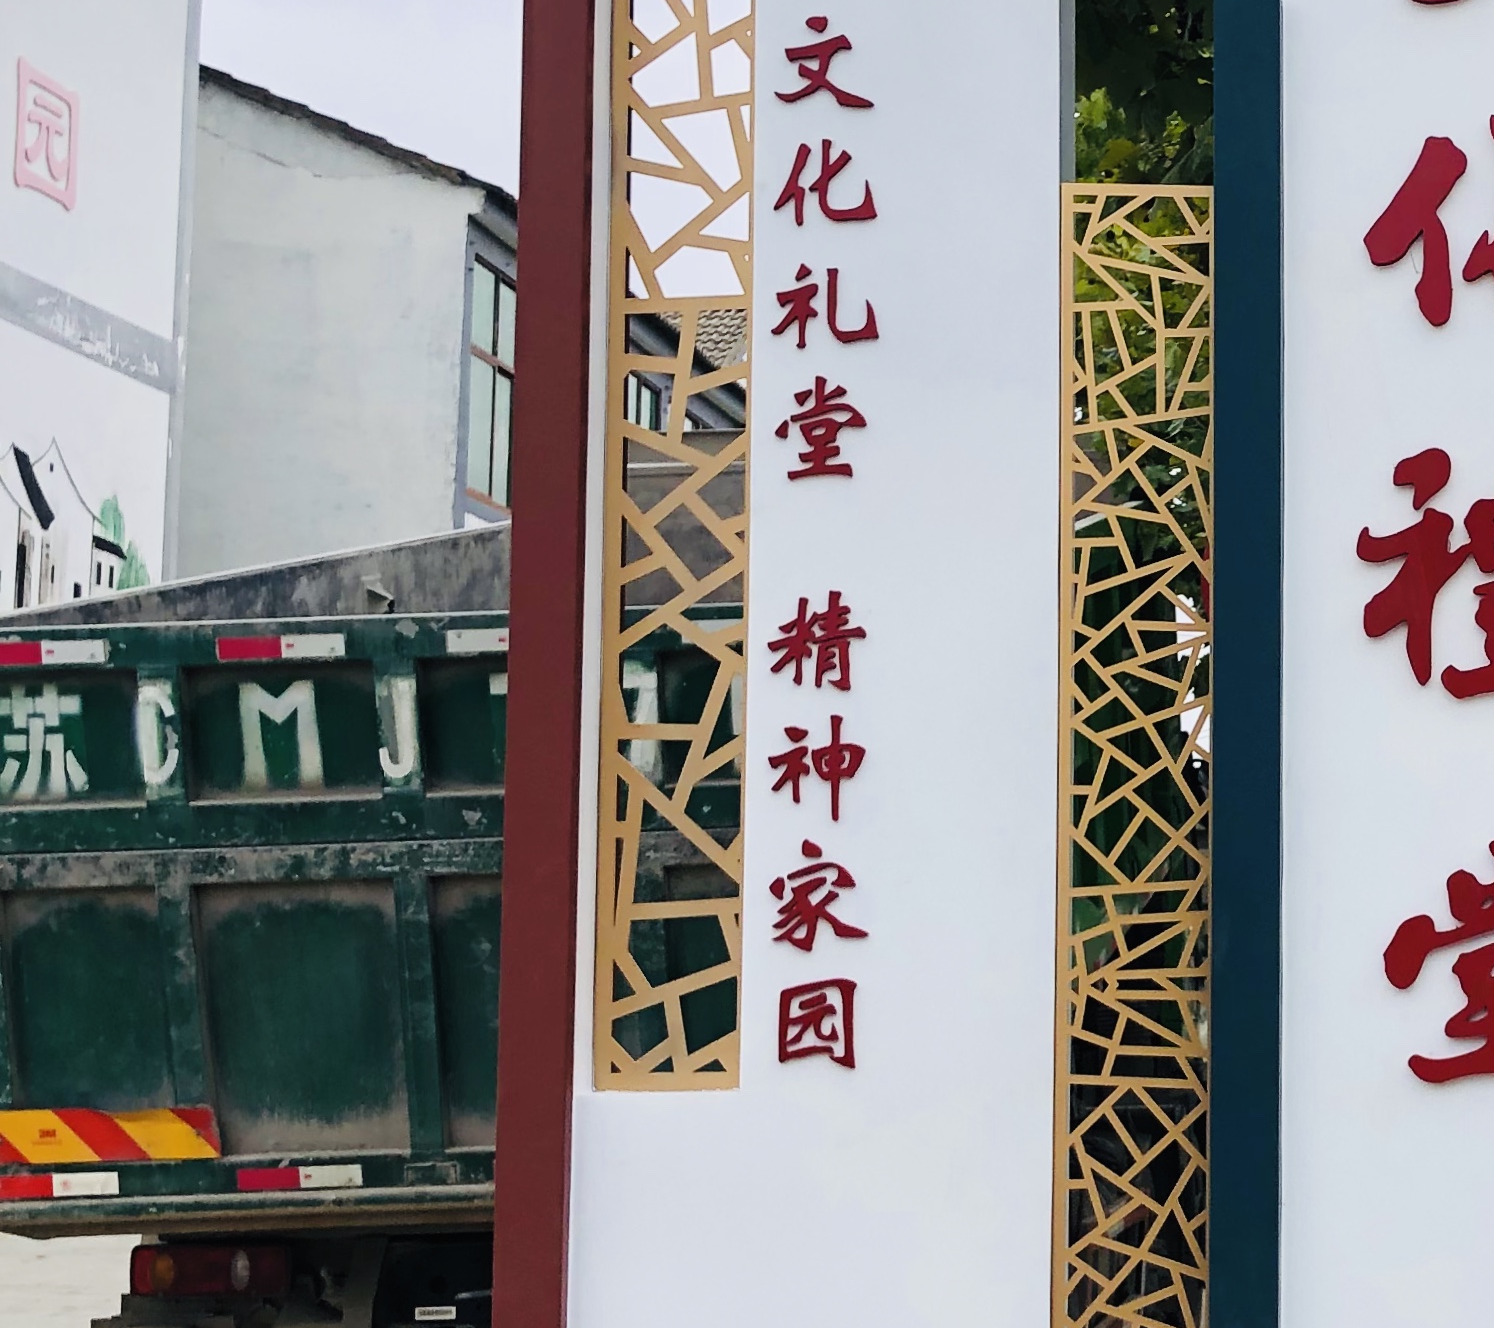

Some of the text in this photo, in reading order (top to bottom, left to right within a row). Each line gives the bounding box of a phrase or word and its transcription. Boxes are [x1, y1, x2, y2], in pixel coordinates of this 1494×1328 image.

[767, 15, 880, 1071] 文化礼堂 精神家园
